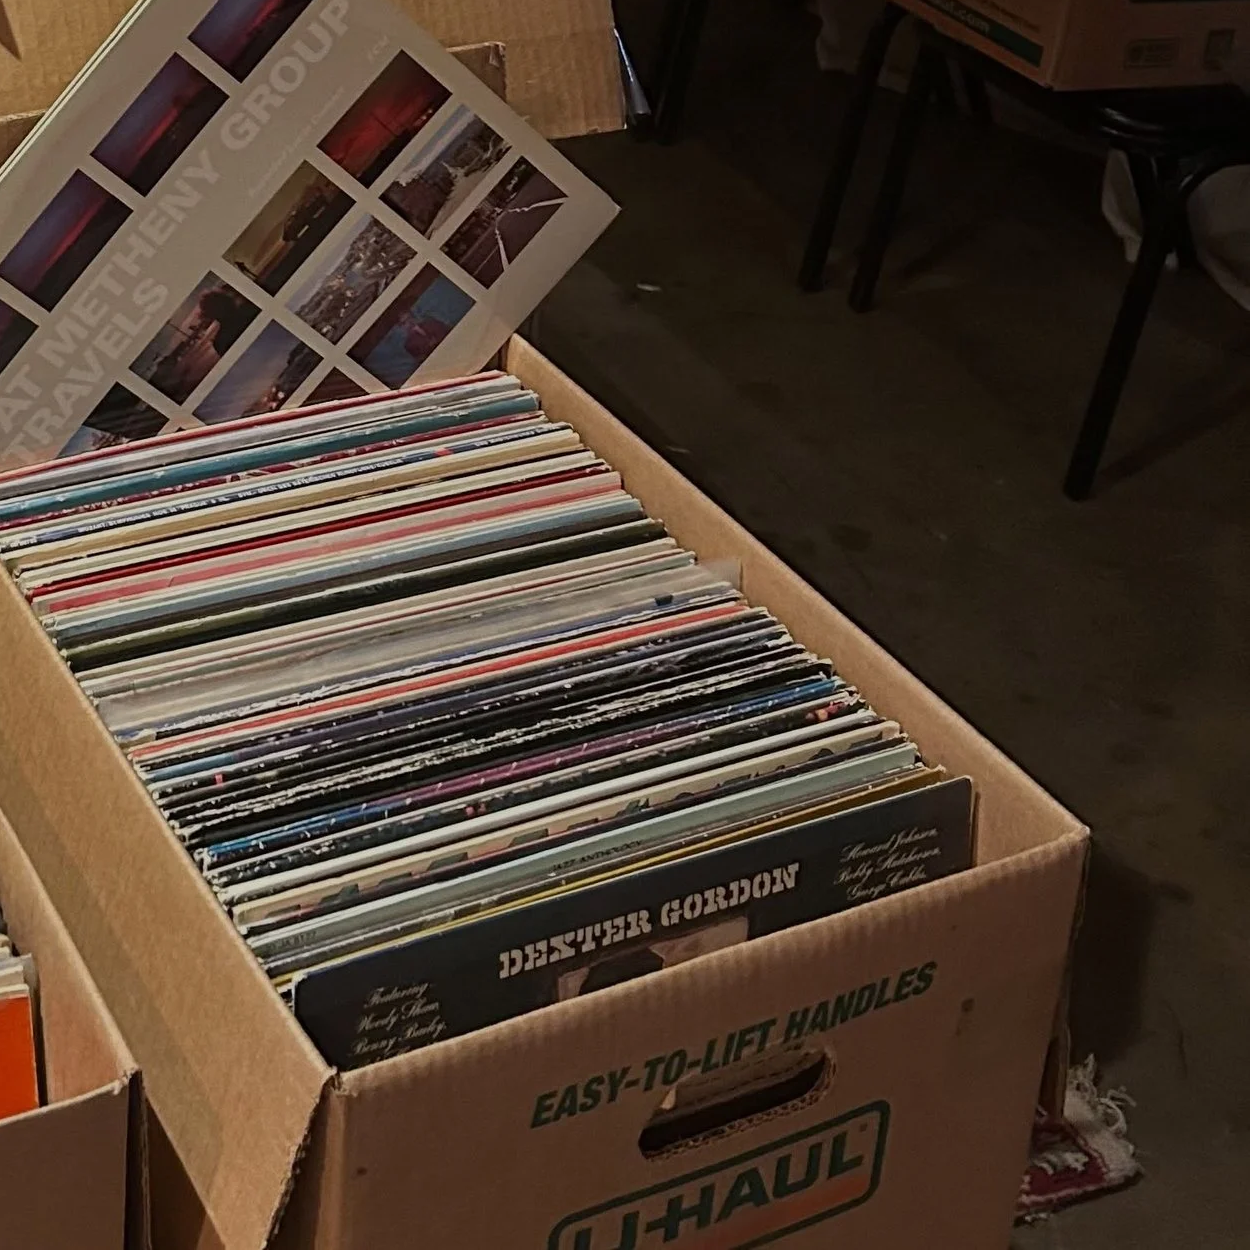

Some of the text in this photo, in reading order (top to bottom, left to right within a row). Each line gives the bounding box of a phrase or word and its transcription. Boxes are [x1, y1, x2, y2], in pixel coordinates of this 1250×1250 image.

[47, 148, 222, 360] METHENY
[3, 279, 170, 464] TRAVELS
[499, 909, 653, 979] DEXTER
[660, 862, 799, 927] GORDON
[530, 961, 938, 1129] EASY-TO-LIFT HANDLES
[573, 1131, 865, 1250] U-HAUL
